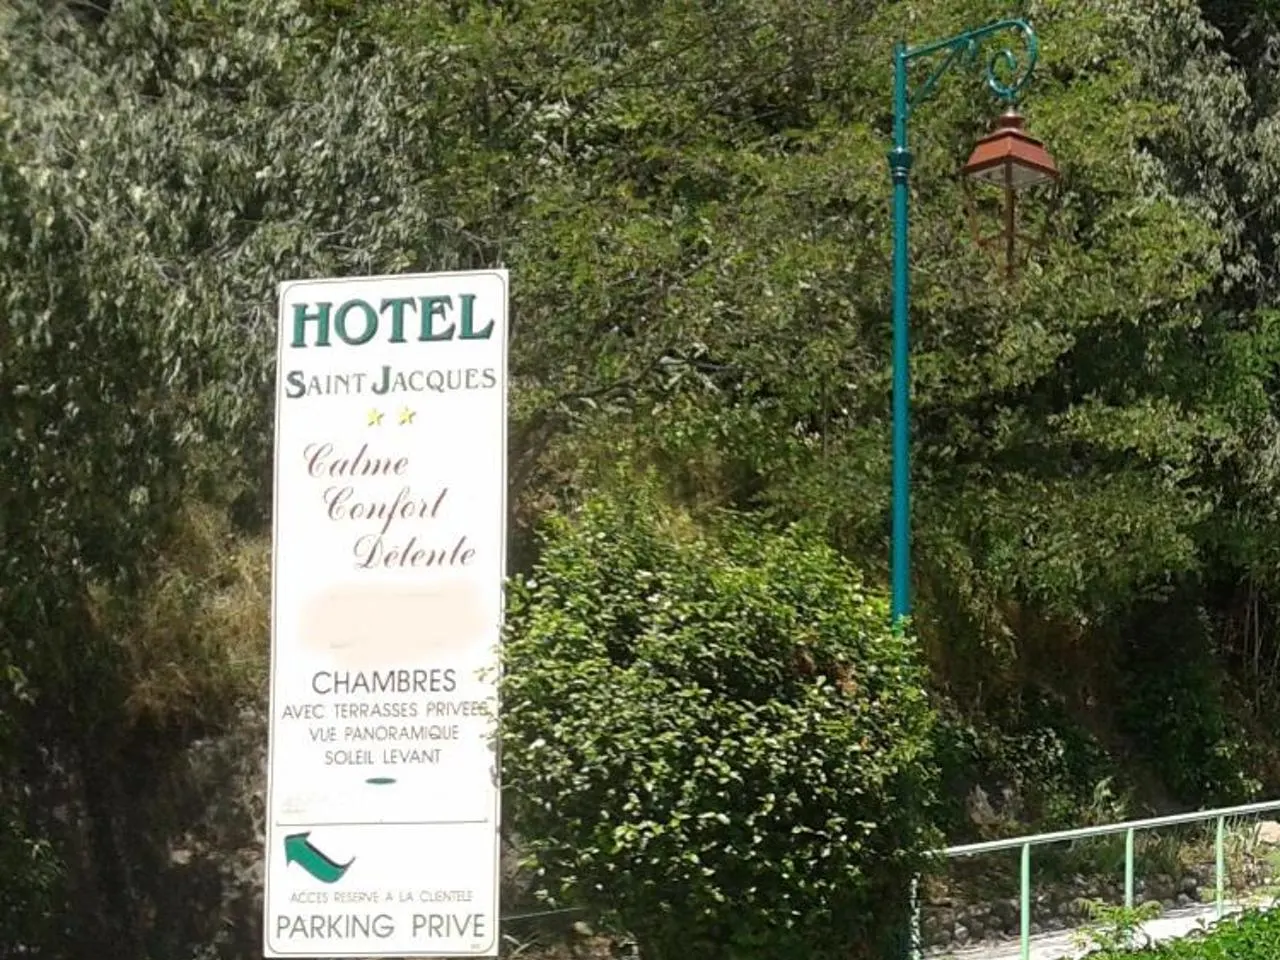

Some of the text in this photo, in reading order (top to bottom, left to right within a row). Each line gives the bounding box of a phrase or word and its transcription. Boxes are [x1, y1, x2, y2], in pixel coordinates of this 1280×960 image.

[290, 293, 495, 348] HOTEL
[303, 443, 409, 478] Calme
[323, 486, 449, 535] Confort
[311, 669, 457, 695] CHAMBRES
[281, 703, 325, 719] AVEC
[334, 702, 418, 719] TERRASSES
[308, 725, 460, 742] VUE PANORAMIQUE
[324, 749, 442, 766] SOLEIL LEVANT
[399, 890, 414, 903] LA
[419, 889, 474, 903] CLIENTELE
[276, 913, 486, 939] PARKING PRIVE
